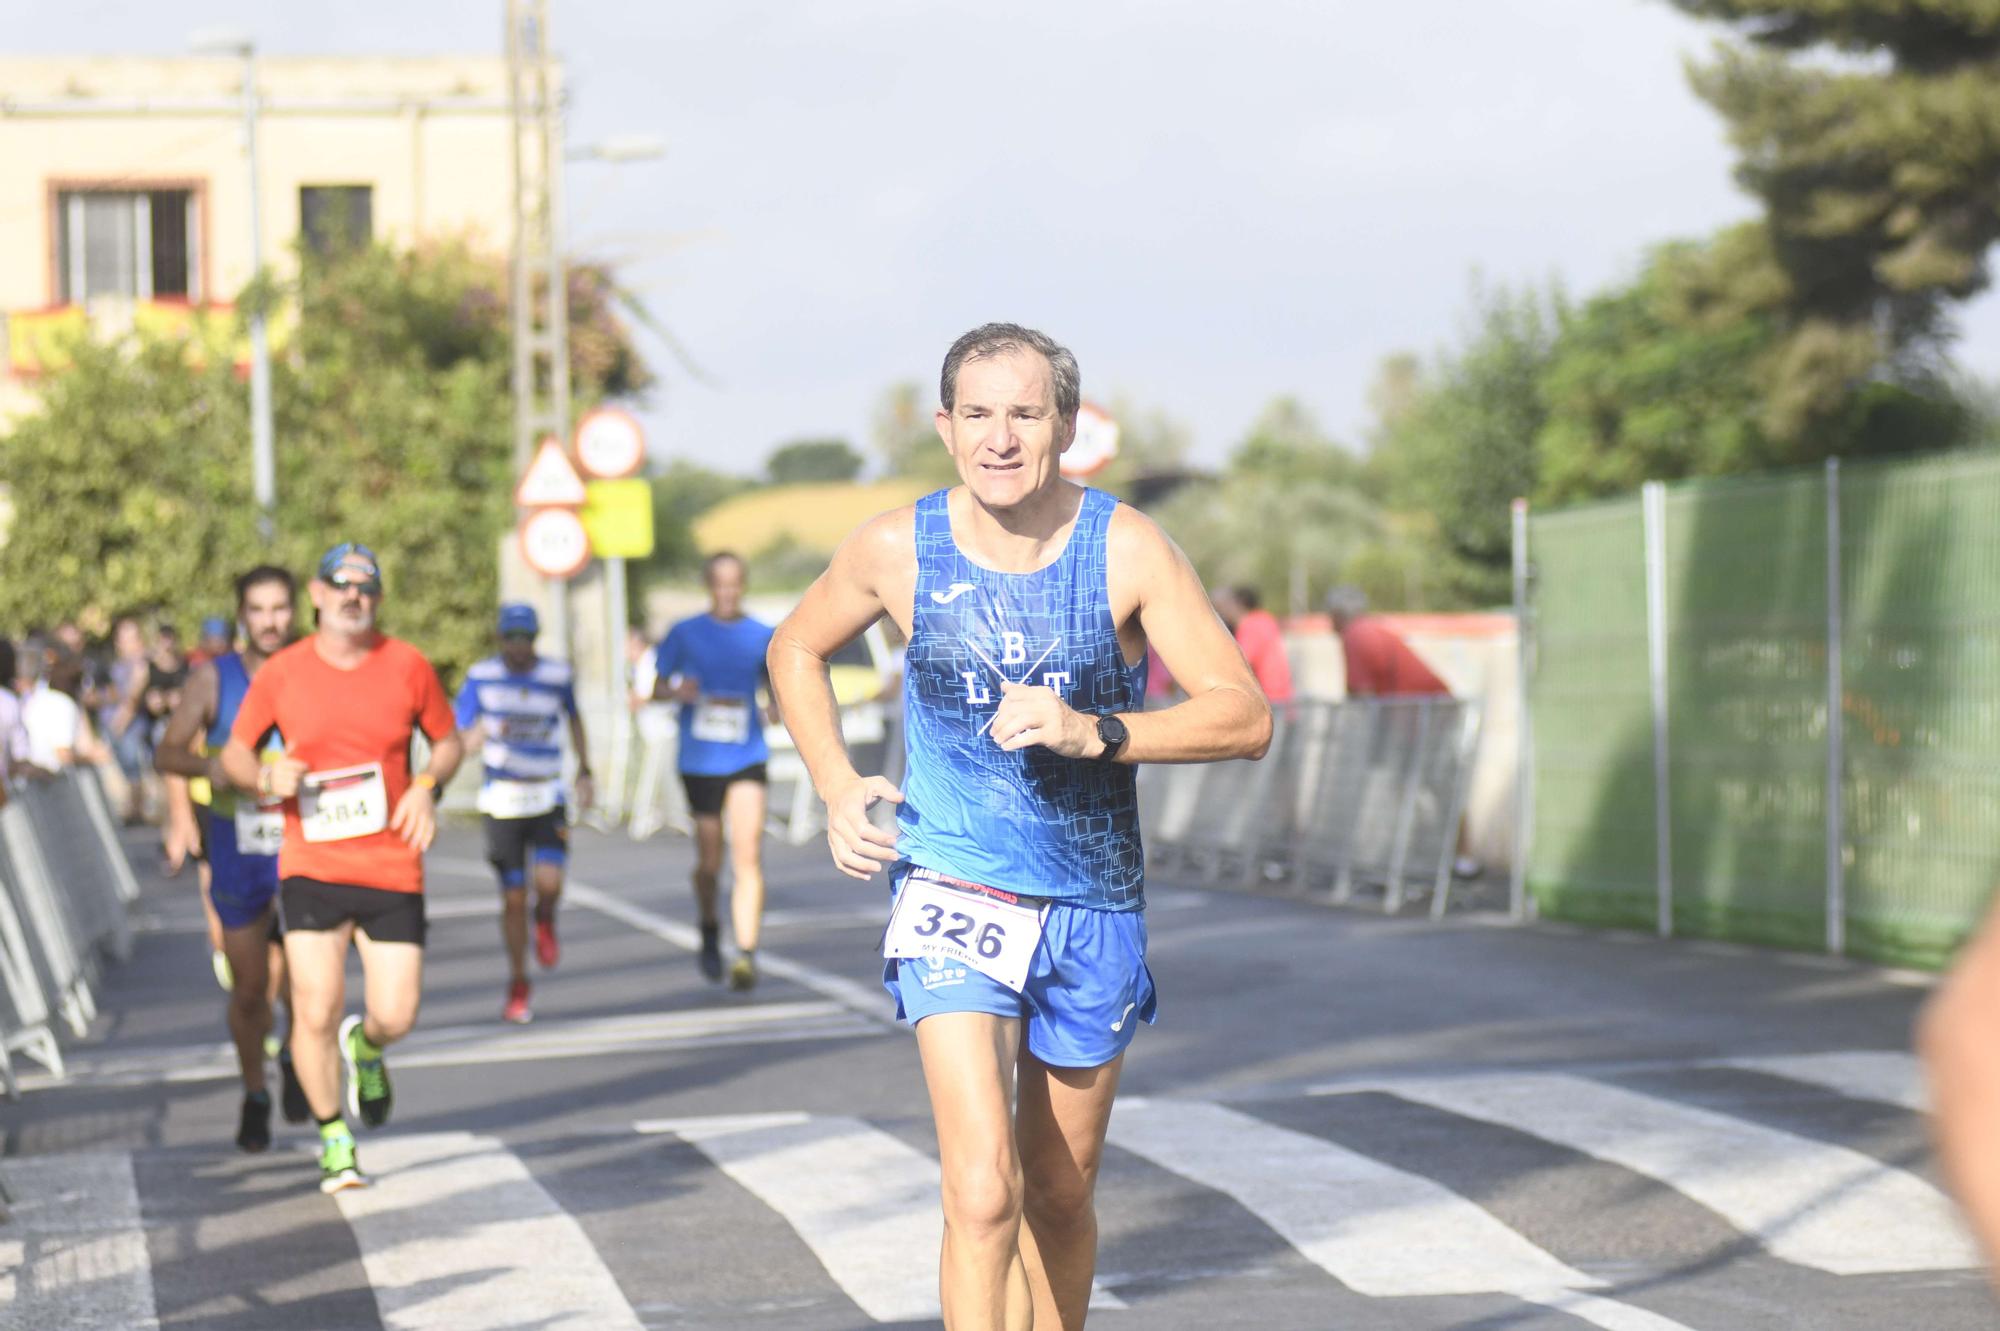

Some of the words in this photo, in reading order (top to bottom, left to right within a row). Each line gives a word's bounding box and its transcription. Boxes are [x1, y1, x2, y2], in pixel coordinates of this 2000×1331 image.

[1001, 631, 1026, 665] B
[961, 671, 991, 704] L
[1043, 671, 1070, 701] T
[913, 902, 1007, 960] 326
[922, 943, 937, 951] MY
